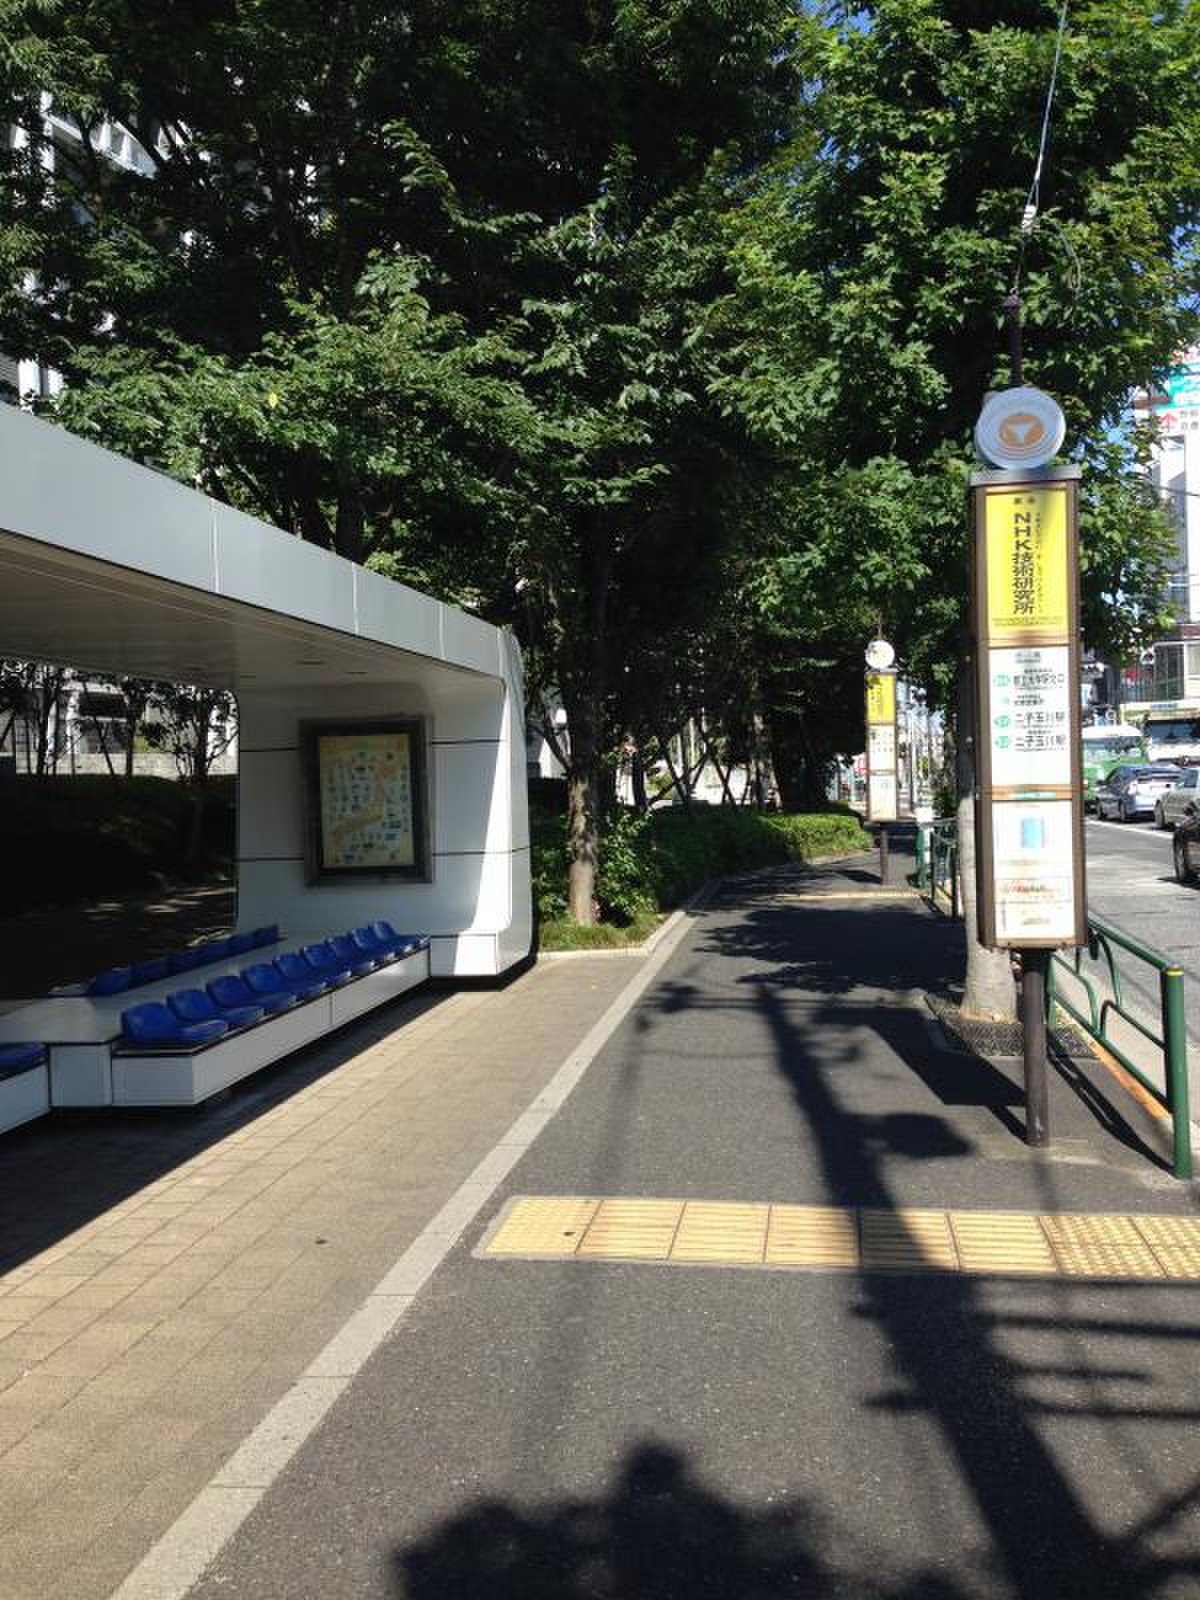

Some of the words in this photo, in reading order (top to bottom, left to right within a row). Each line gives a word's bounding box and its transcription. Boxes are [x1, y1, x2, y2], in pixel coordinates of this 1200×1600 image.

[1012, 512, 1035, 614] NHK技術研究所
